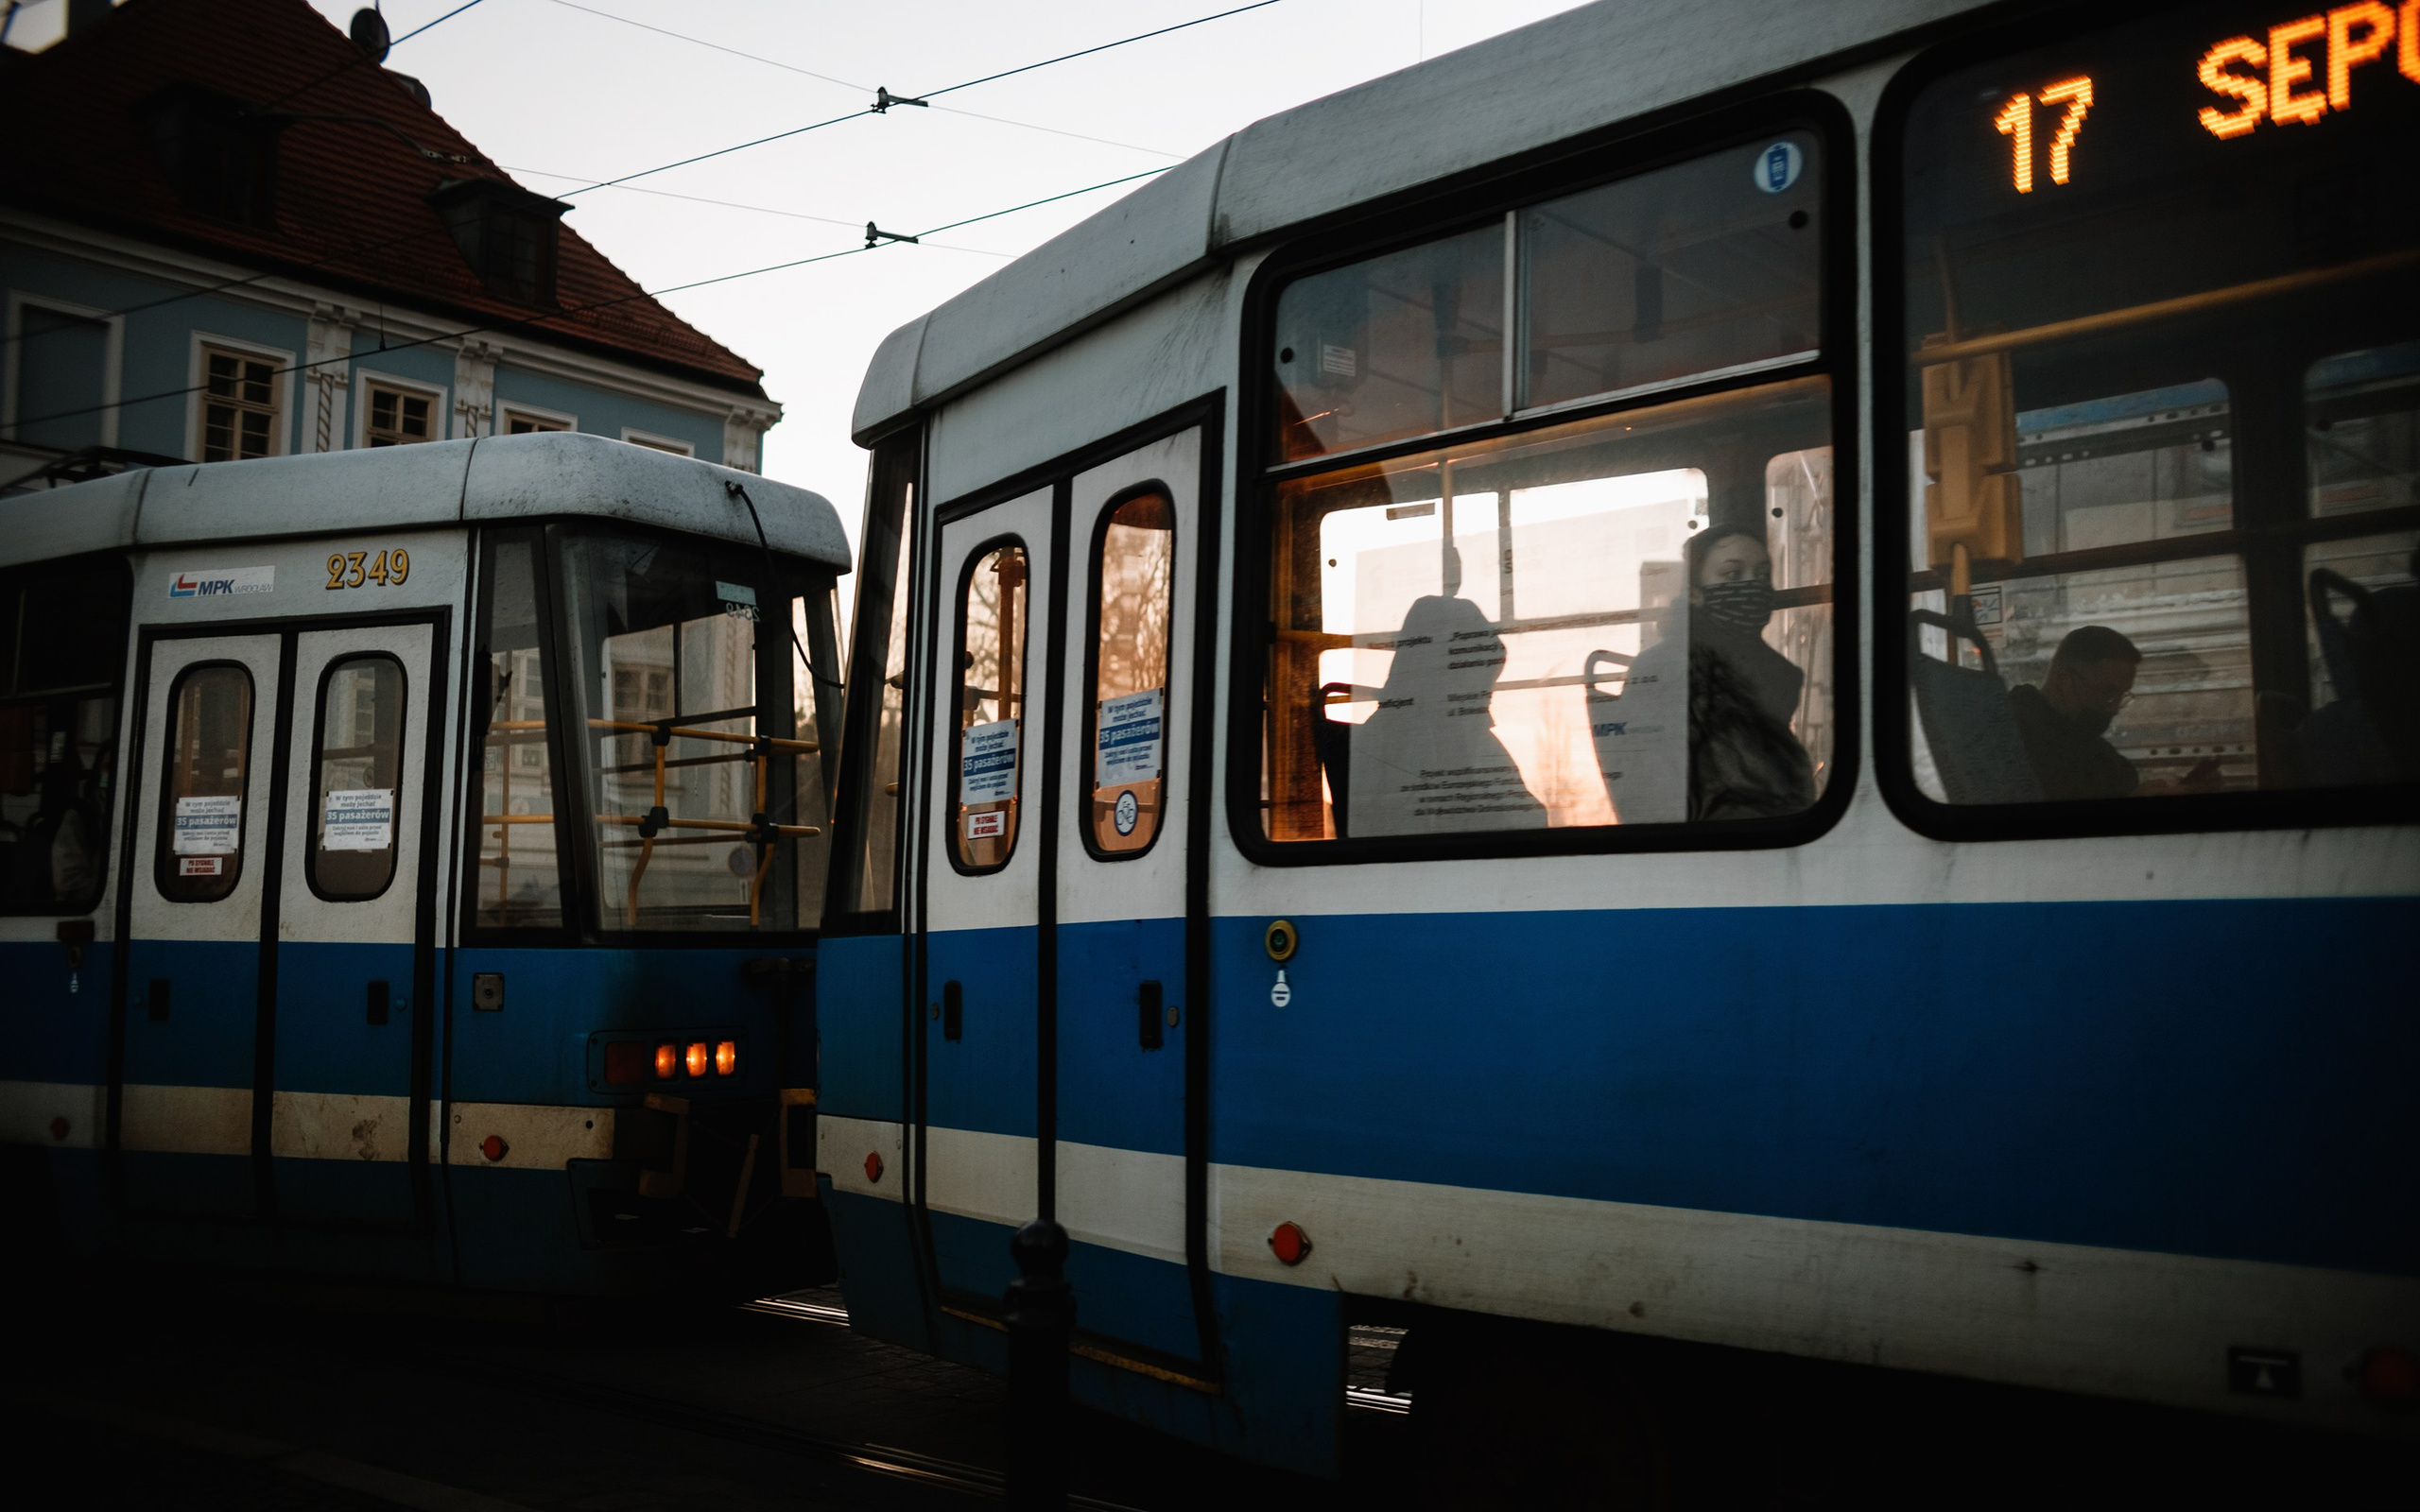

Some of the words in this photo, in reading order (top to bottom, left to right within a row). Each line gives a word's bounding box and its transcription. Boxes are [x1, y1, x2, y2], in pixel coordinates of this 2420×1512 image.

[1995, 75, 2094, 194] 17
[325, 549, 410, 590] 2349
[198, 579, 235, 595] MPK
[1100, 730, 1109, 744] 35
[1110, 721, 1160, 745] pasażerów
[963, 759, 973, 771] 35
[177, 816, 187, 826] 35
[189, 815, 237, 828] pasażerów
[326, 811, 337, 820] 35
[338, 809, 389, 822] pasażerów
